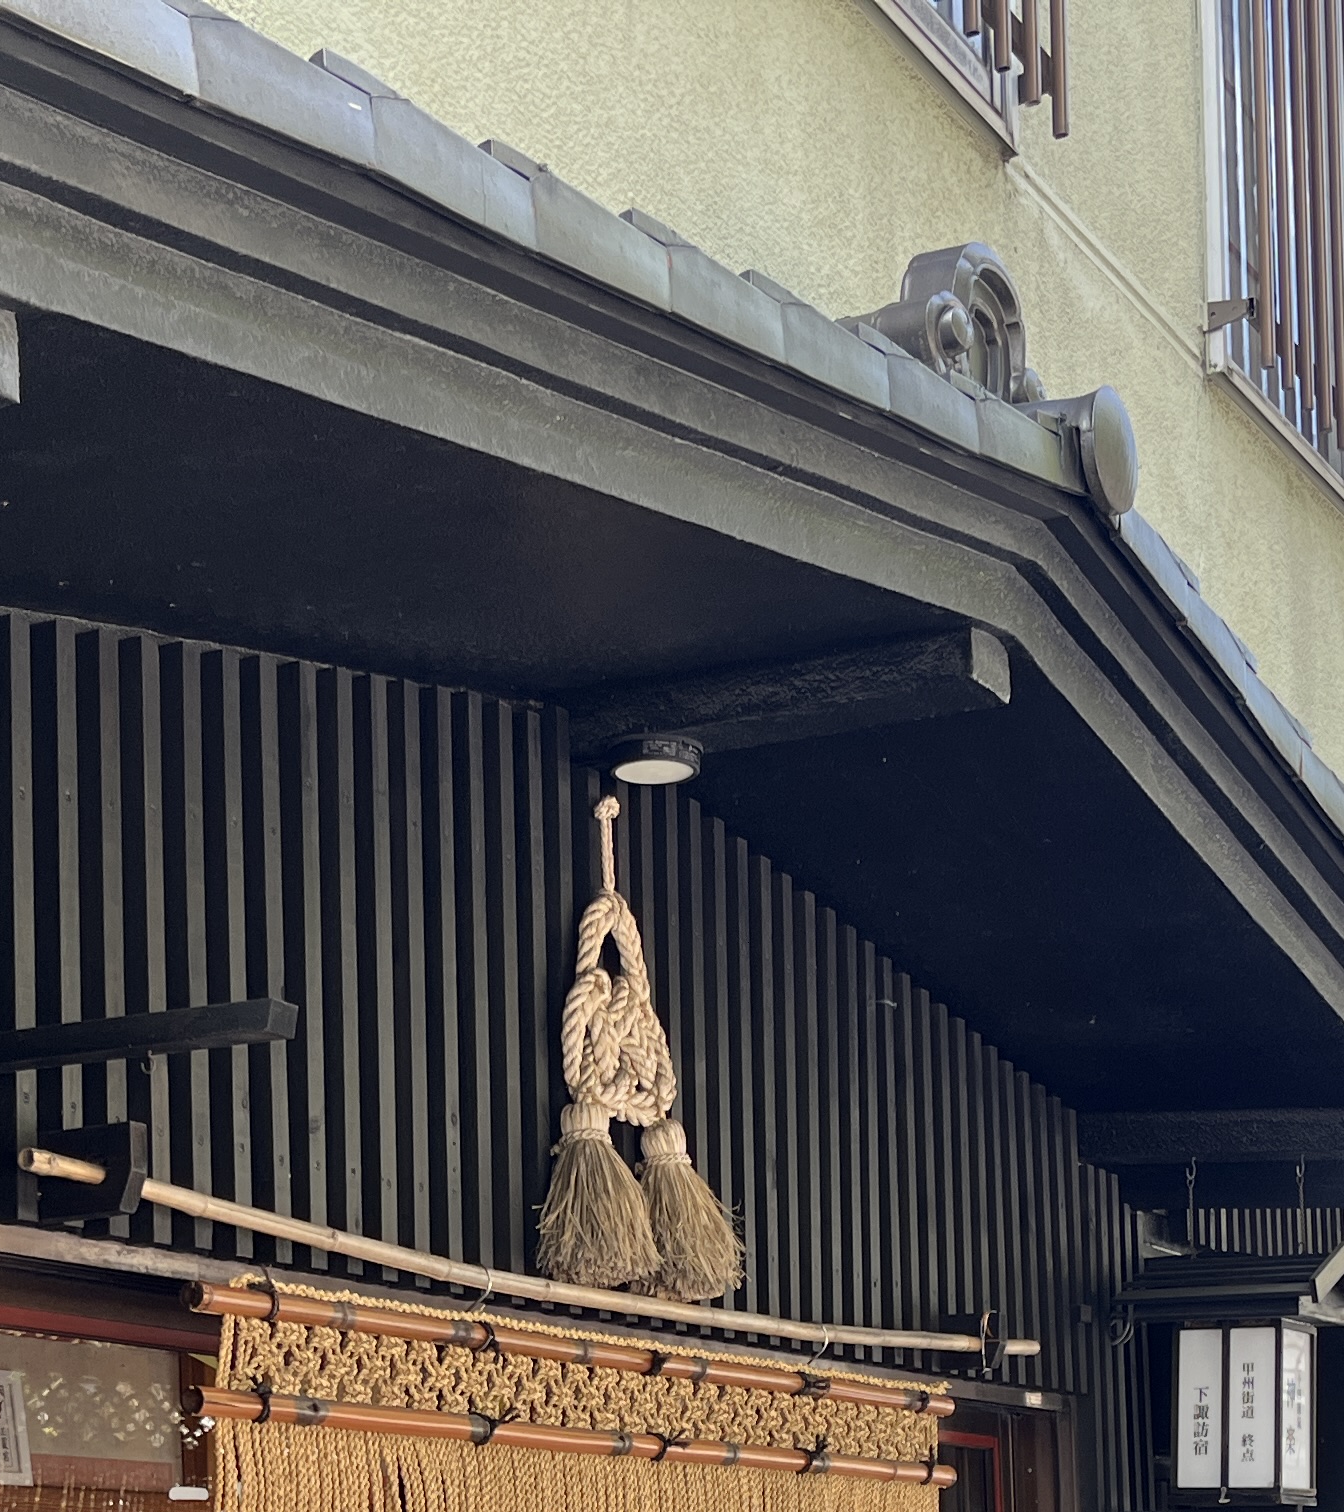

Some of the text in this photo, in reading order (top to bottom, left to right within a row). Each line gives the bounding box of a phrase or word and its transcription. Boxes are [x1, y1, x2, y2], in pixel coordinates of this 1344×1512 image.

[1192, 1385, 1210, 1456] 下諏訪宿
[1241, 1362, 1255, 1462] 甲州街道 終点
